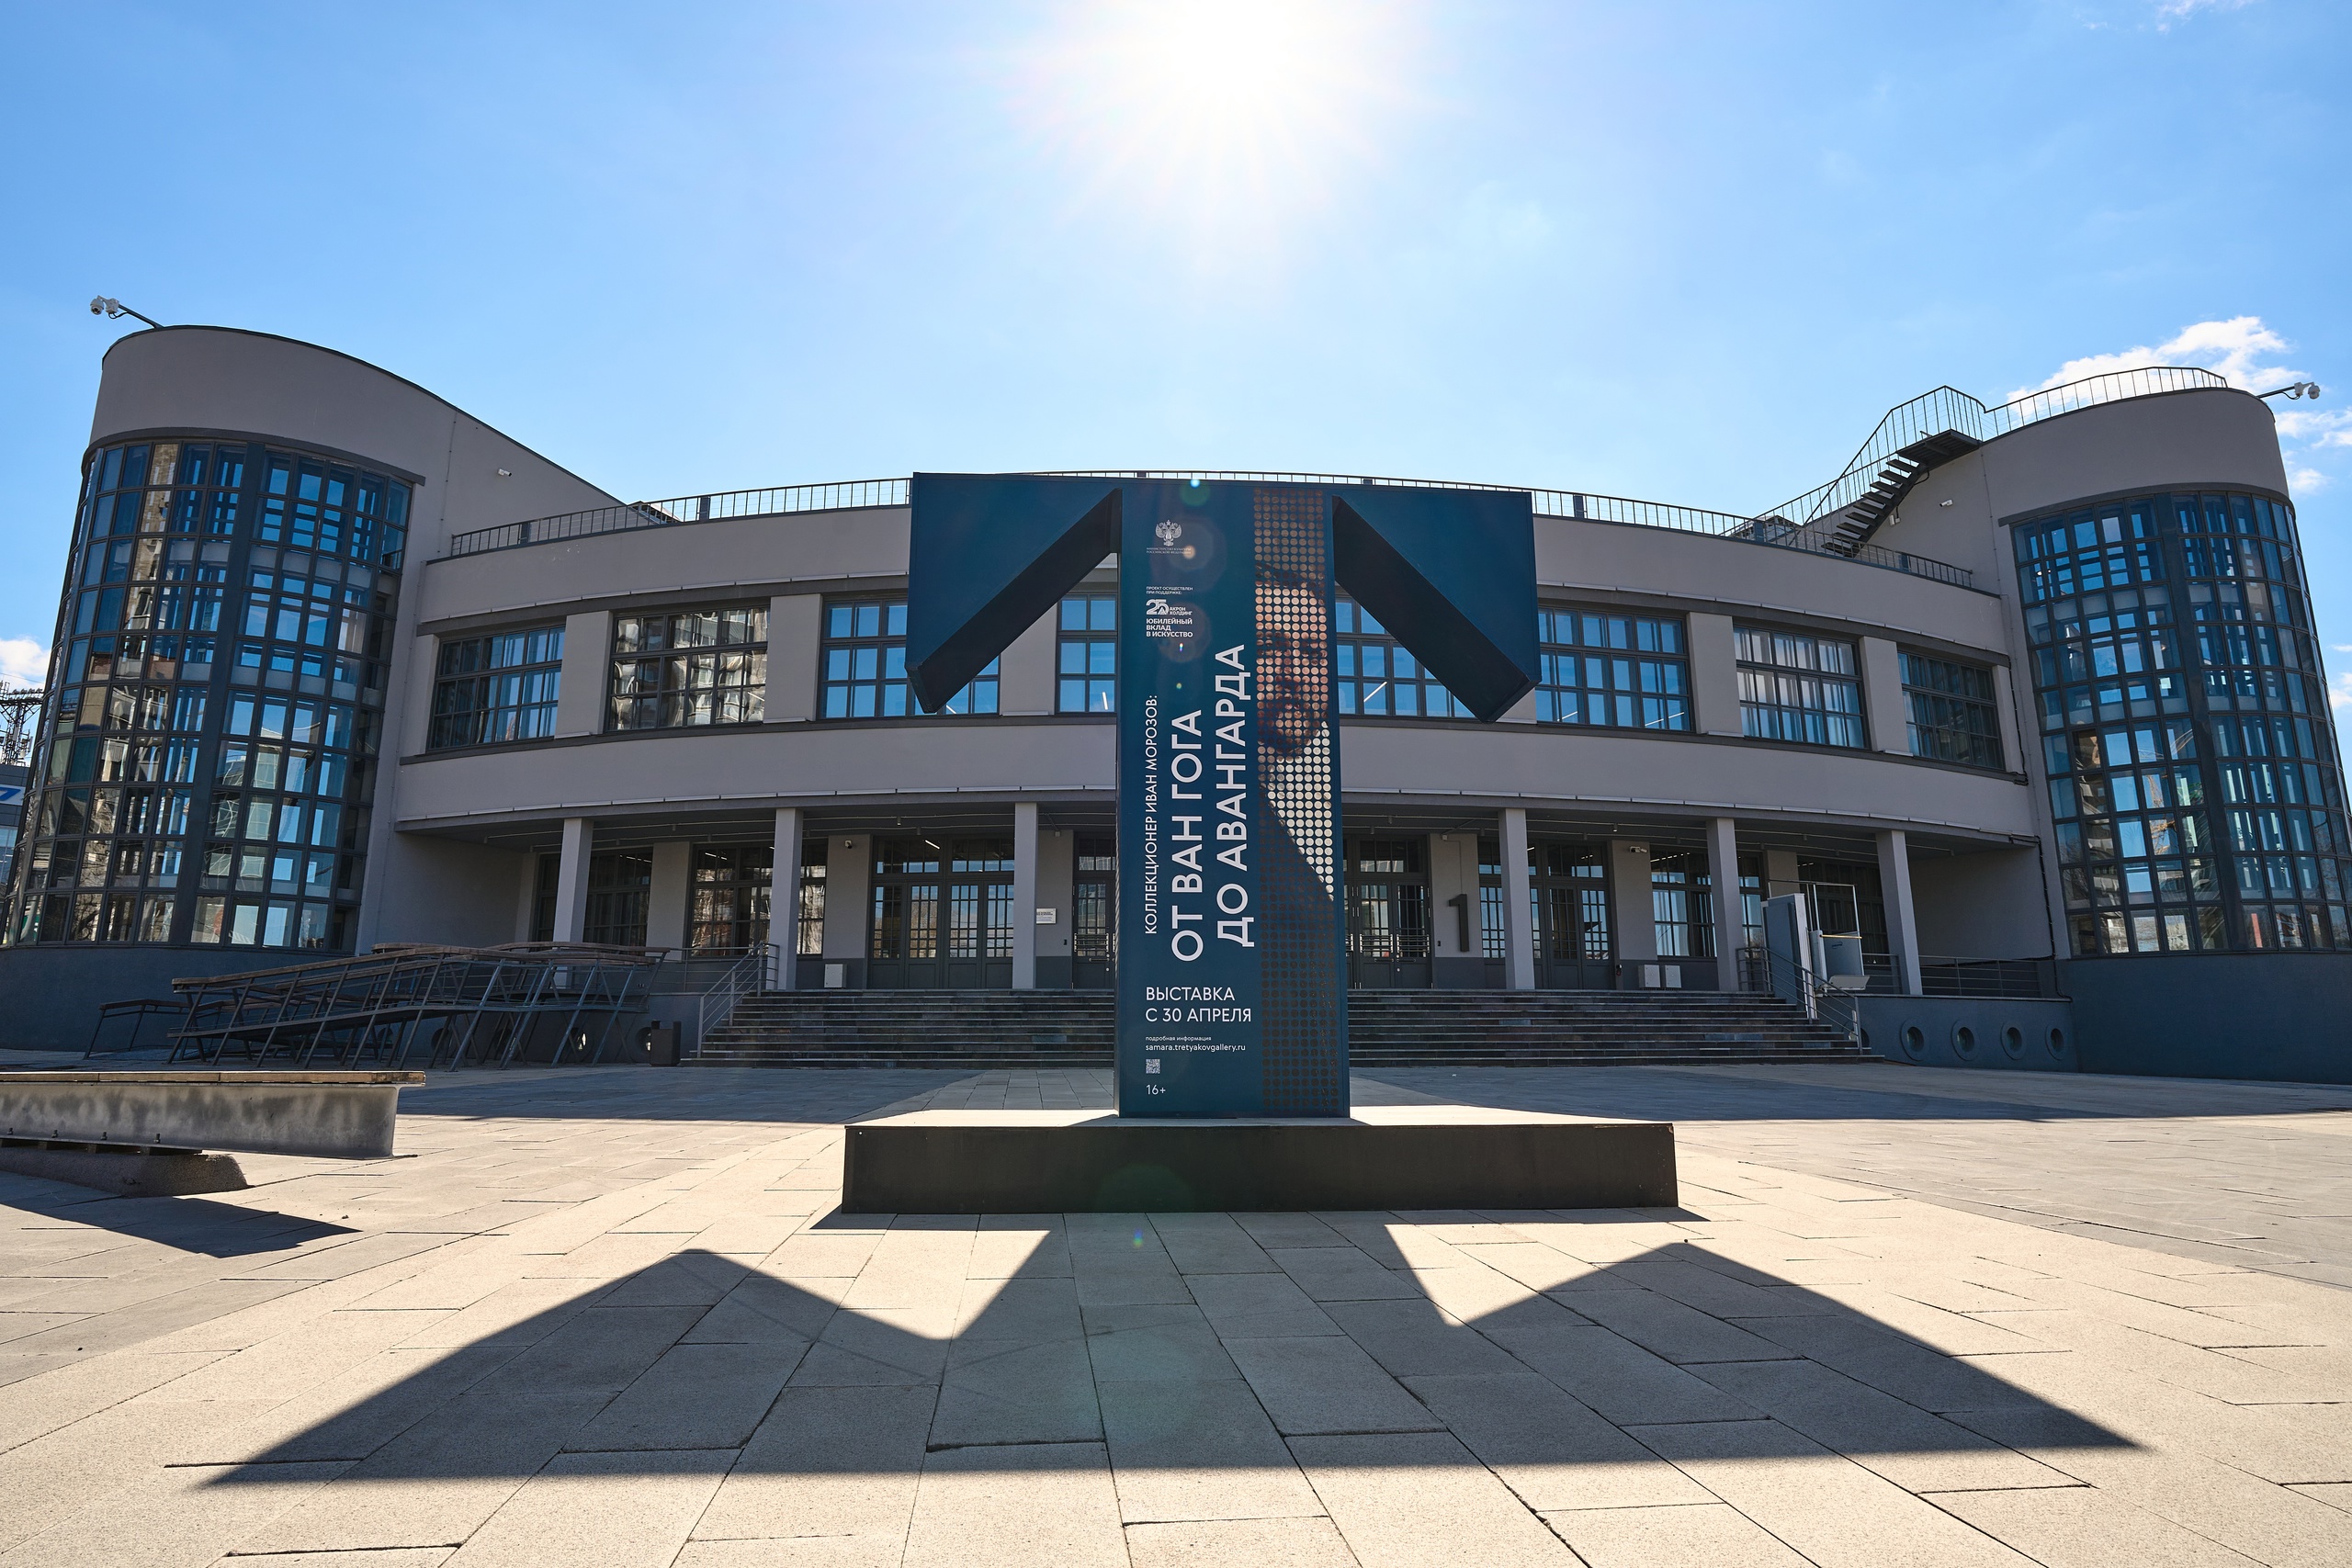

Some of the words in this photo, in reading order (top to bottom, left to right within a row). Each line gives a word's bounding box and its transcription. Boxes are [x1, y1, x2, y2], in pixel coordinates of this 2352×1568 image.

[1145, 694, 1158, 771] МОРОЗОВ:
[1170, 709, 1203, 799] ГОГА
[1215, 644, 1251, 872] АВАНГАРДА
[1145, 774, 1158, 813] ИВАН
[1145, 816, 1159, 934] КОЛЛЕКЦИОНЕР
[1171, 816, 1203, 893] ВАН
[1171, 905, 1204, 962] ОТ
[1216, 883, 1255, 947] ДО
[1449, 894, 1470, 952] 1
[1145, 1008, 1158, 1022] С
[1162, 1008, 1182, 1022] 30
[1186, 1008, 1251, 1022] АПРЕЛЯ
[1146, 987, 1236, 1001] ВЫСТАВКА
[1145, 1043, 1246, 1053] samara.tretyakovgallery.ru
[1146, 1084, 1166, 1095] 16+
